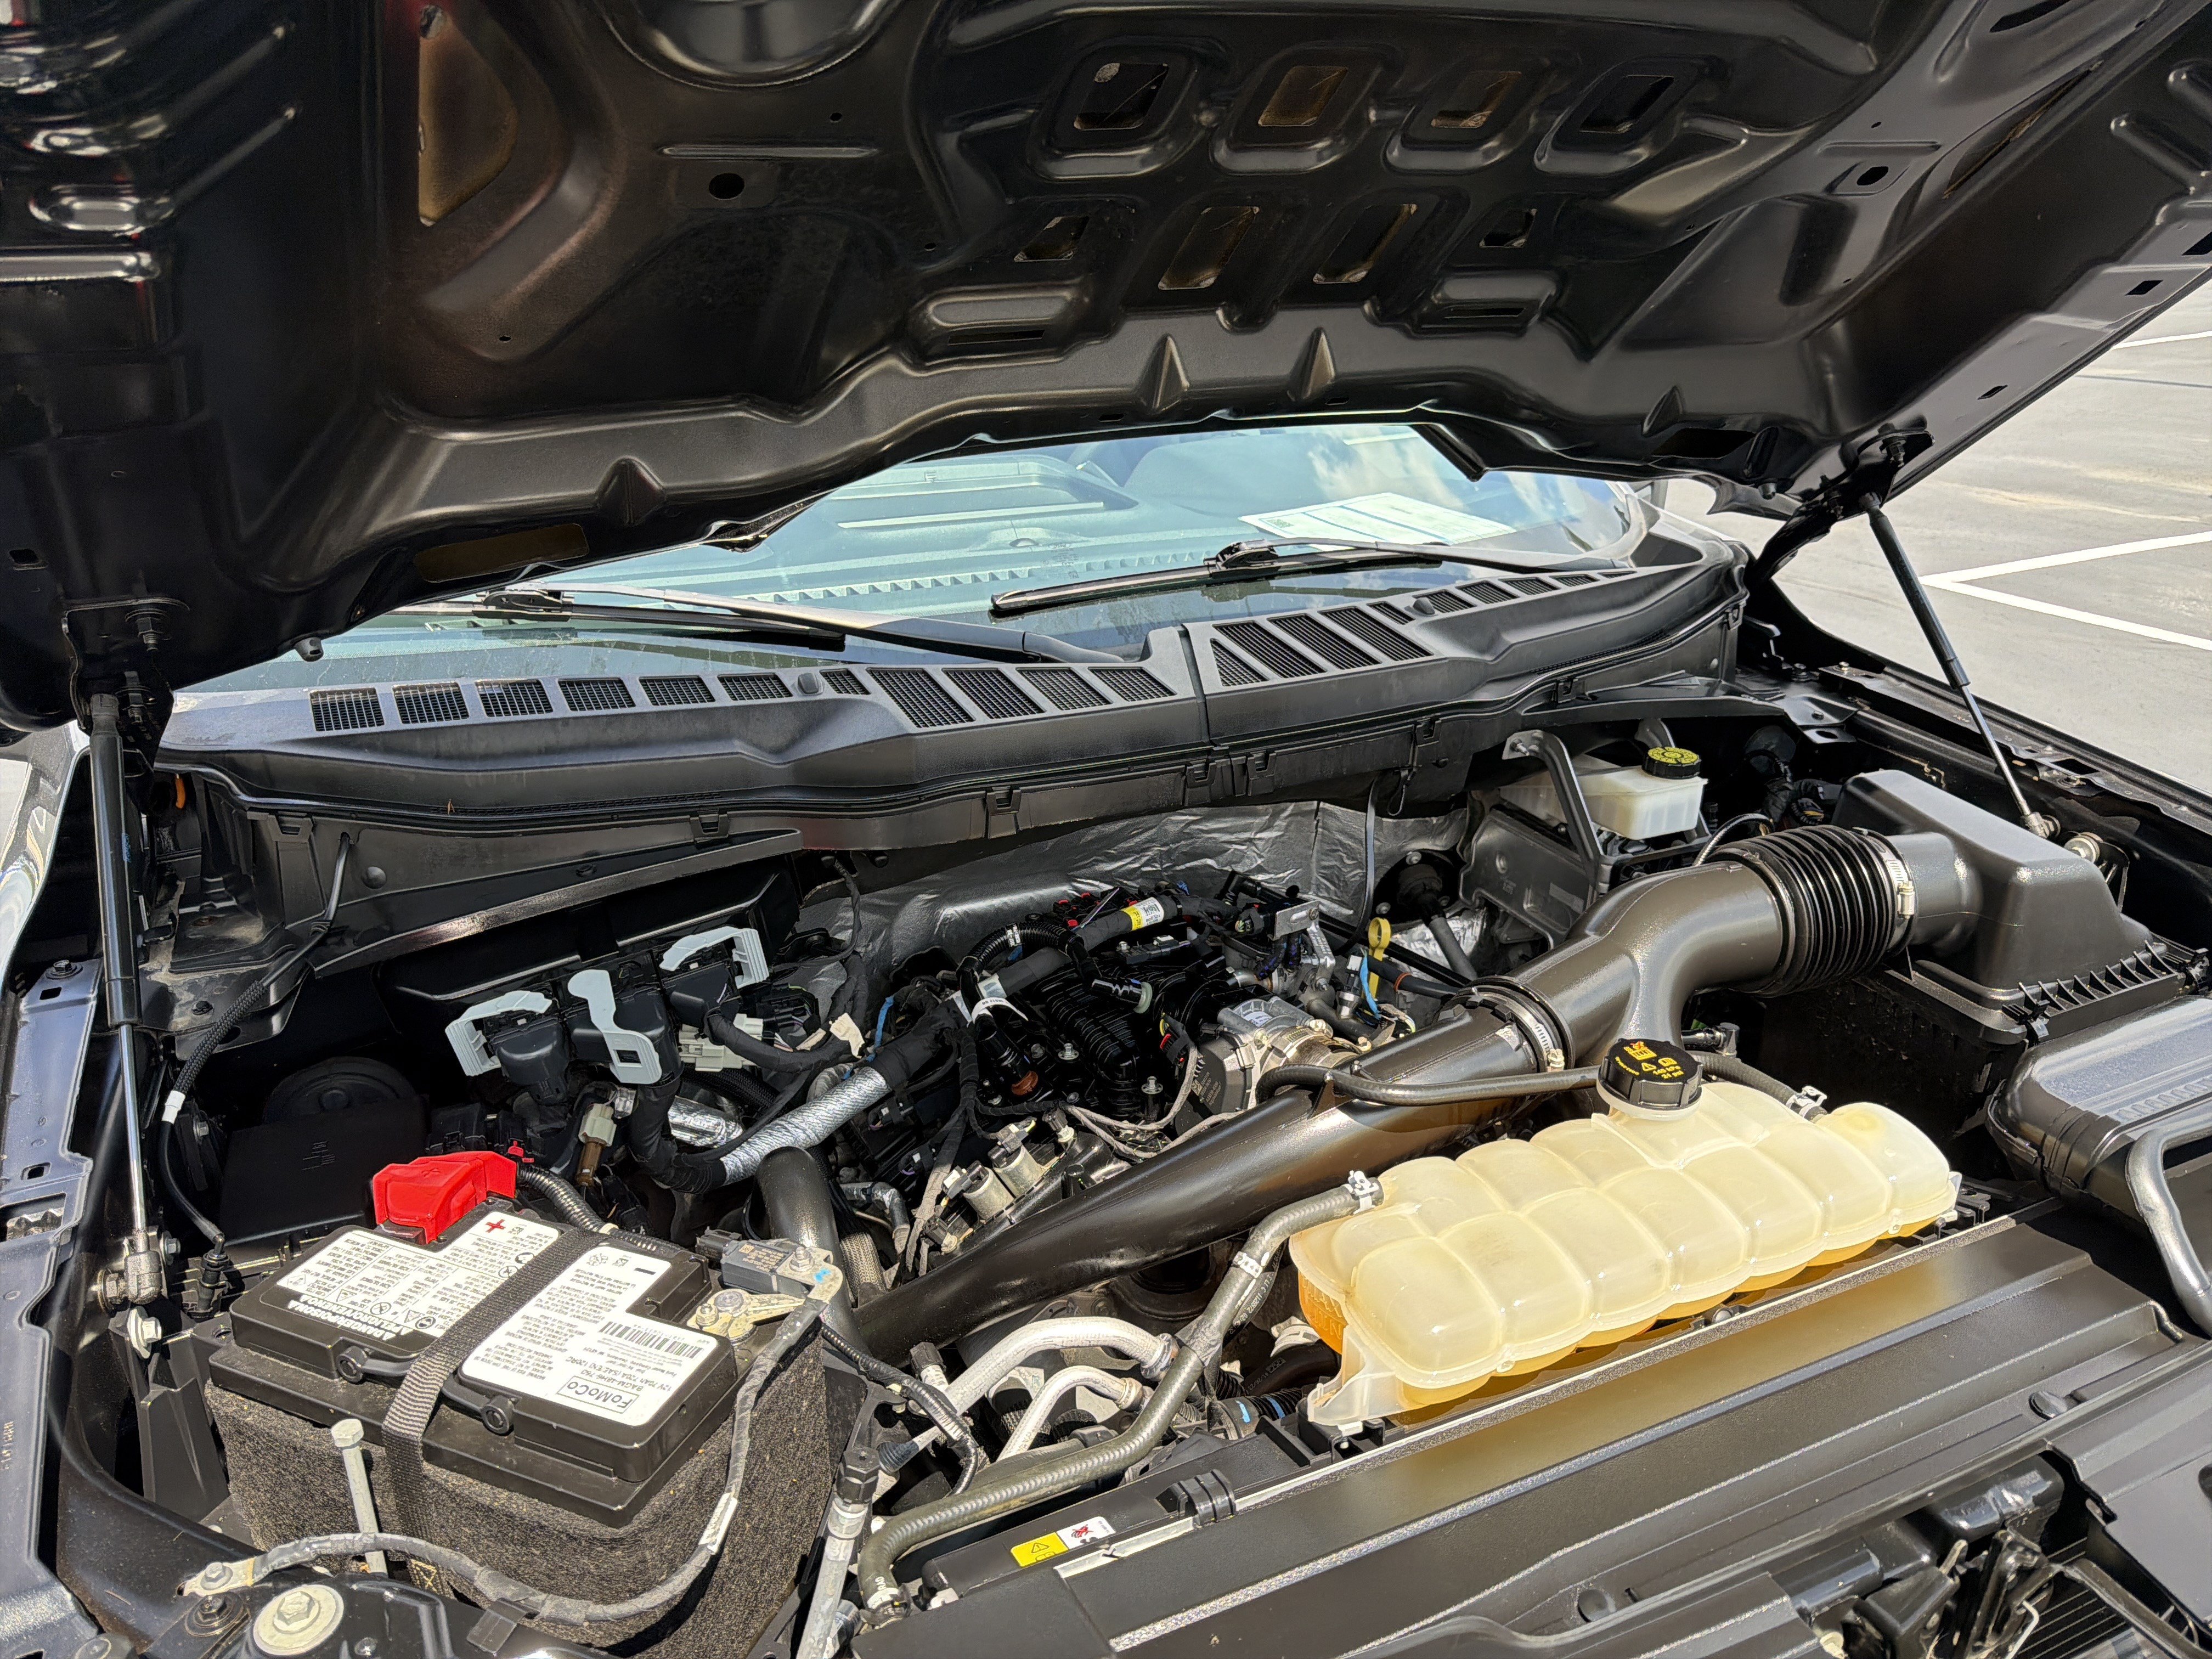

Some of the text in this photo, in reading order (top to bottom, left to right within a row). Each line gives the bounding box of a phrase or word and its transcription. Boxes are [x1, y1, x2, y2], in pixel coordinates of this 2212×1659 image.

[637, 1377, 659, 1387] 70Ah
[657, 1383, 673, 1392] 12V
[562, 1380, 634, 1409] FoMoCo
[875, 1576, 885, 1590] RAD
